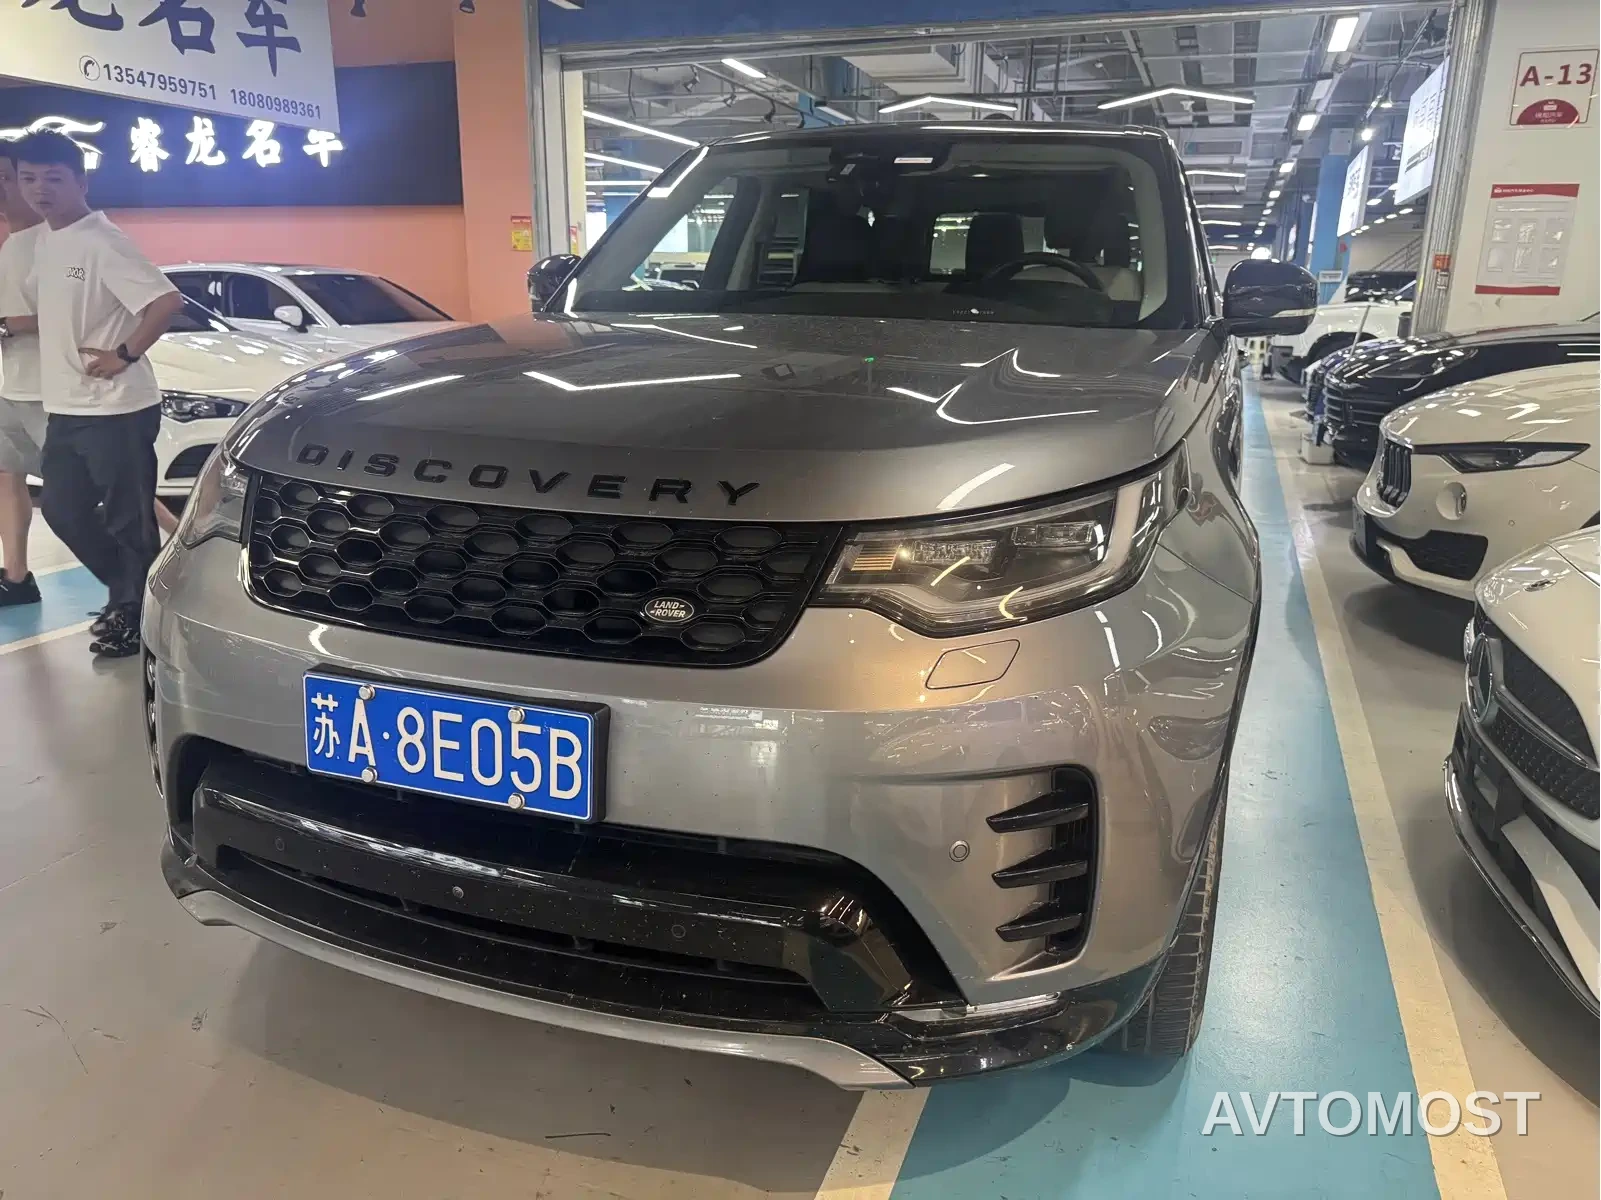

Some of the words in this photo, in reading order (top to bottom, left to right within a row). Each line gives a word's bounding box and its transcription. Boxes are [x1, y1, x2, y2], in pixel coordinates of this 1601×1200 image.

[103, 62, 217, 100] 13547959751
[230, 88, 321, 120] 18080989361
[1519, 63, 1593, 87] A-13
[296, 443, 760, 506] DISCOVERY
